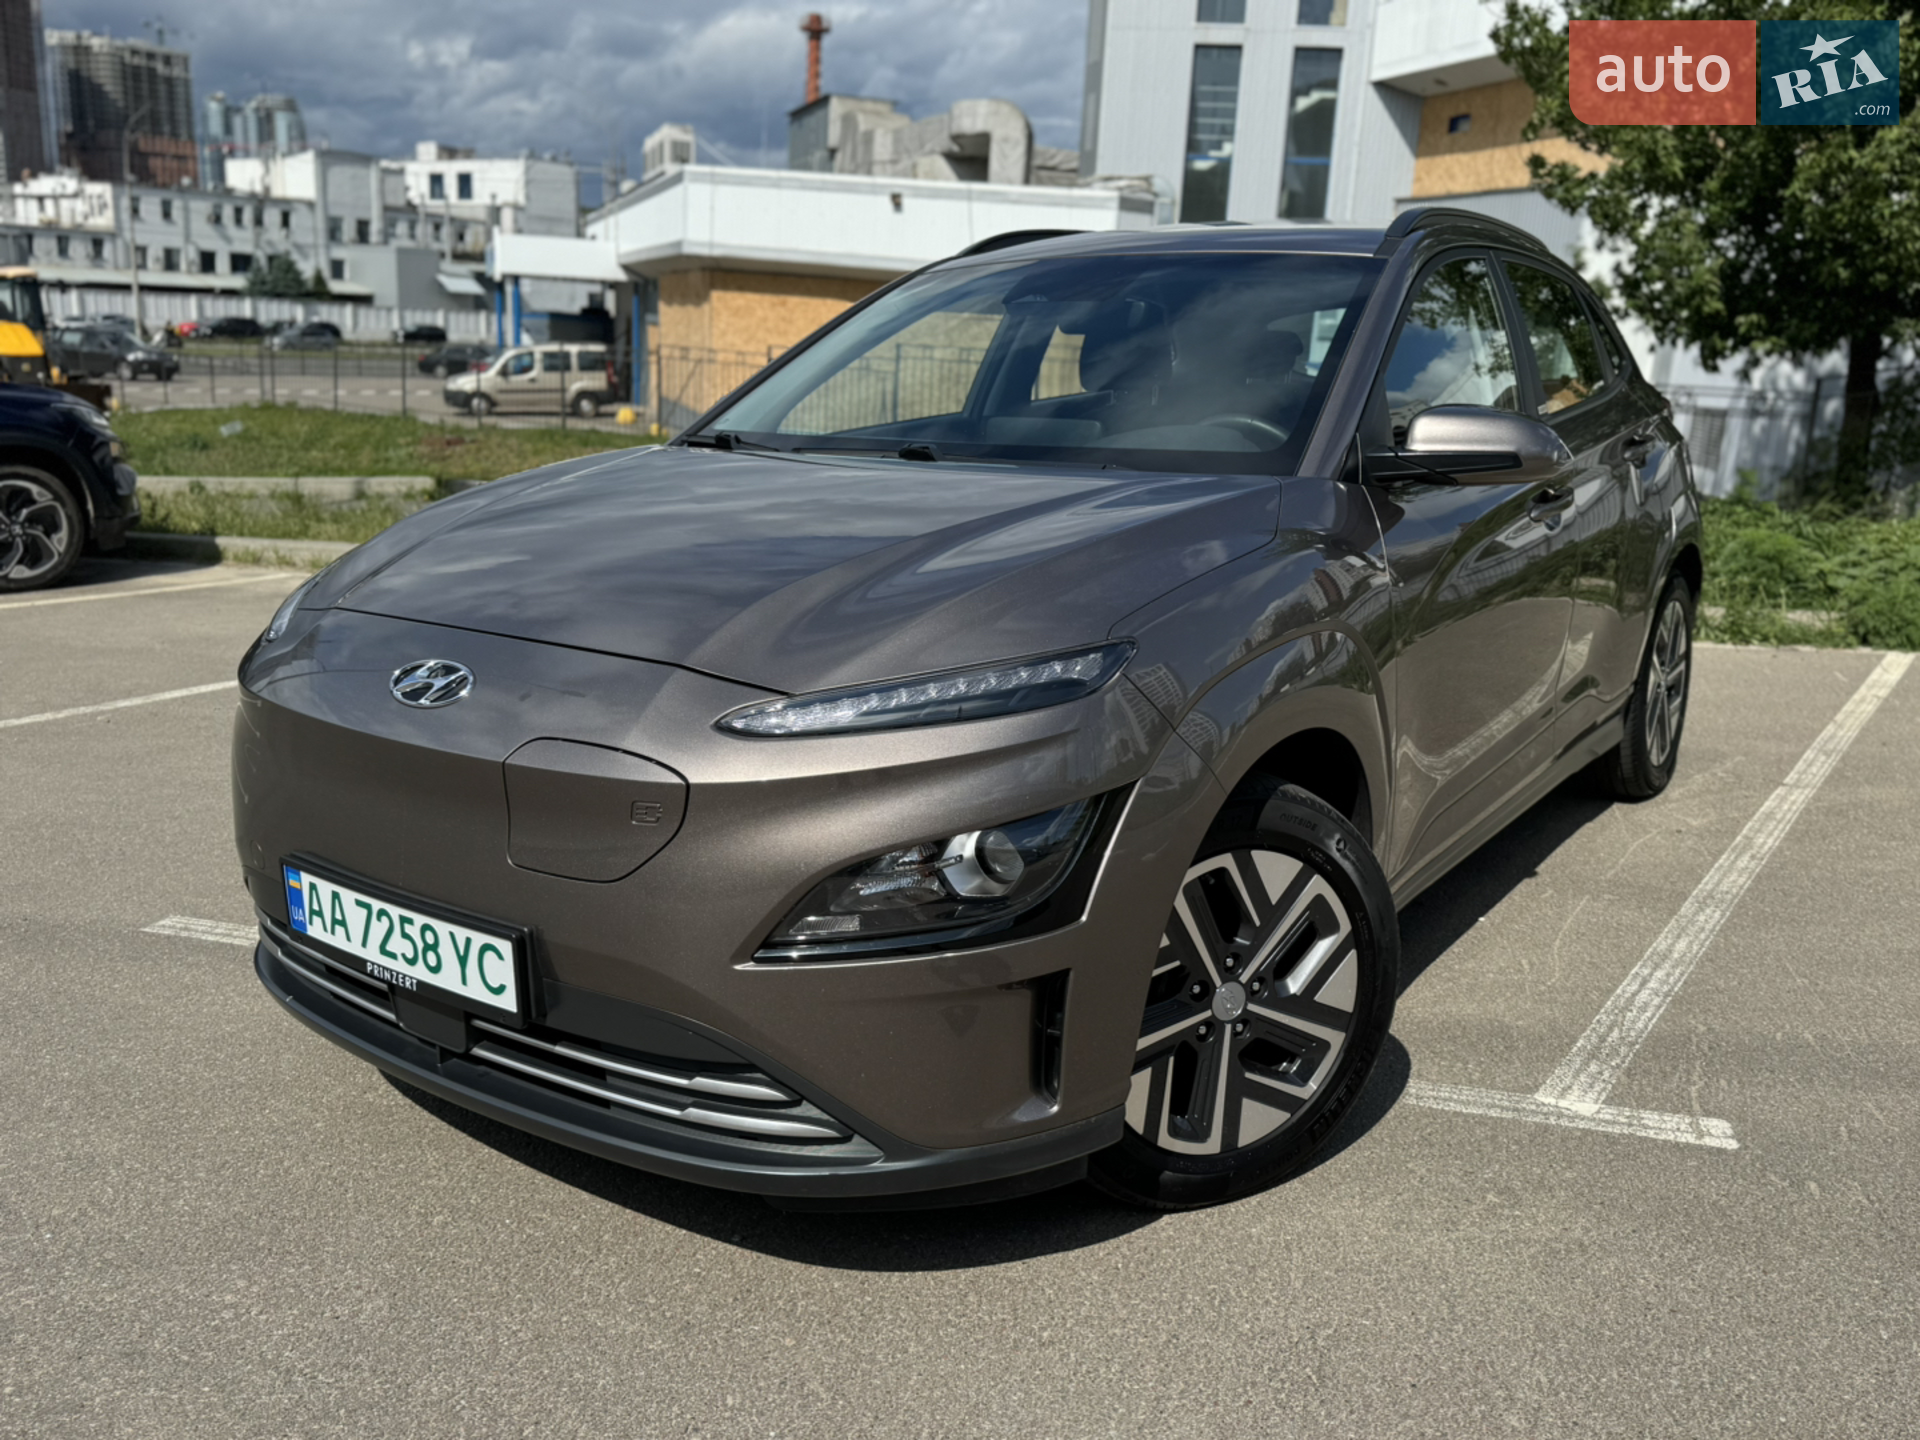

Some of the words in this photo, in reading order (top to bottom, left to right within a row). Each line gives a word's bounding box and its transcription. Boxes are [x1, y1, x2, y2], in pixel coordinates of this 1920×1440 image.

[1280, 813, 1318, 832] OUTSIDE
[291, 904, 306, 923] UA
[308, 881, 351, 942] AA
[354, 898, 444, 975] 7258
[449, 931, 507, 996] YC
[366, 961, 417, 991] PRINZERT
